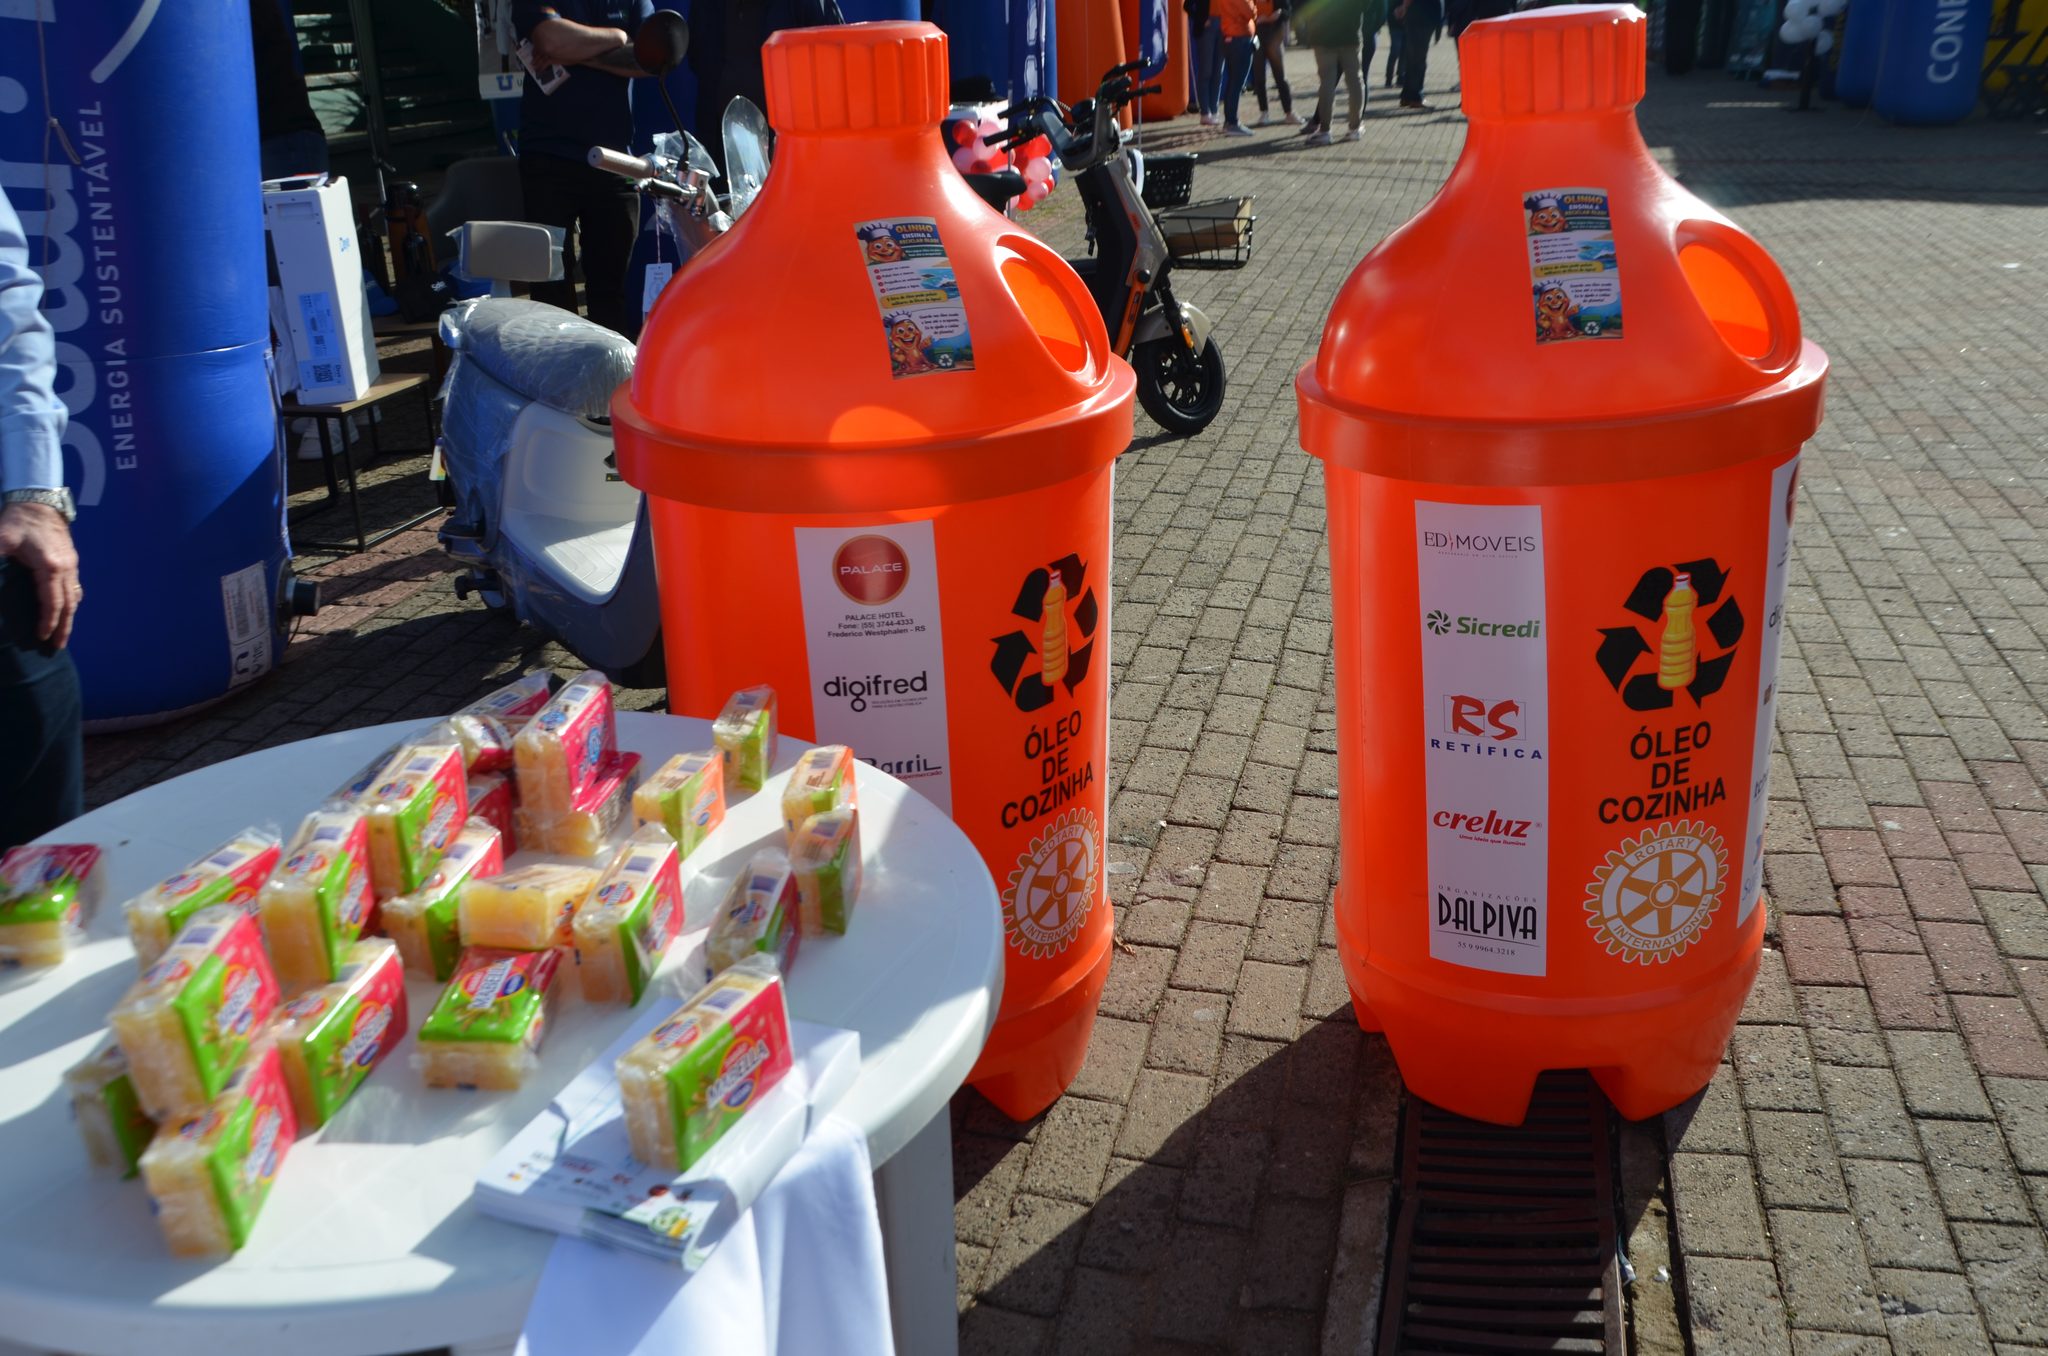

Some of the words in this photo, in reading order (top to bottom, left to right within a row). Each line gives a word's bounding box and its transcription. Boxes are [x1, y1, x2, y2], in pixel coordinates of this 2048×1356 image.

[78, 101, 124, 325] SUSTENTÁVEL
[896, 224, 934, 234] OLINHO
[106, 337, 137, 471] ENERGIA
[1456, 535, 1536, 552] MOVEIS
[840, 562, 902, 576] PALACE
[838, 622, 857, 630] Fone:
[876, 618, 914, 628] 3744-4333
[878, 612, 906, 620] HOTEL
[1456, 616, 1540, 638] Sicredi
[828, 630, 863, 638] Frederico
[865, 628, 908, 636] Westphalen
[824, 670, 928, 712] digifred
[1451, 694, 1520, 741] RS
[1024, 710, 1082, 760] ÓLEO
[1430, 738, 1542, 760] RETÍFICA
[1630, 721, 1711, 760] ÓLEO
[1042, 747, 1069, 785] DE
[1651, 757, 1691, 789] DE
[1001, 760, 1094, 830] COZINHA
[1598, 776, 1726, 824] COZINHA
[1433, 810, 1532, 838] creluz
[1040, 826, 1081, 858] ROTARY
[1634, 837, 1695, 862] ROTARY
[1025, 875, 1093, 944] INTERNATIONAL
[1438, 884, 1537, 903] ORGANIZAÇÕES
[1438, 892, 1536, 940] DALPIVA
[1613, 895, 1711, 950] INTERNATIONAL
